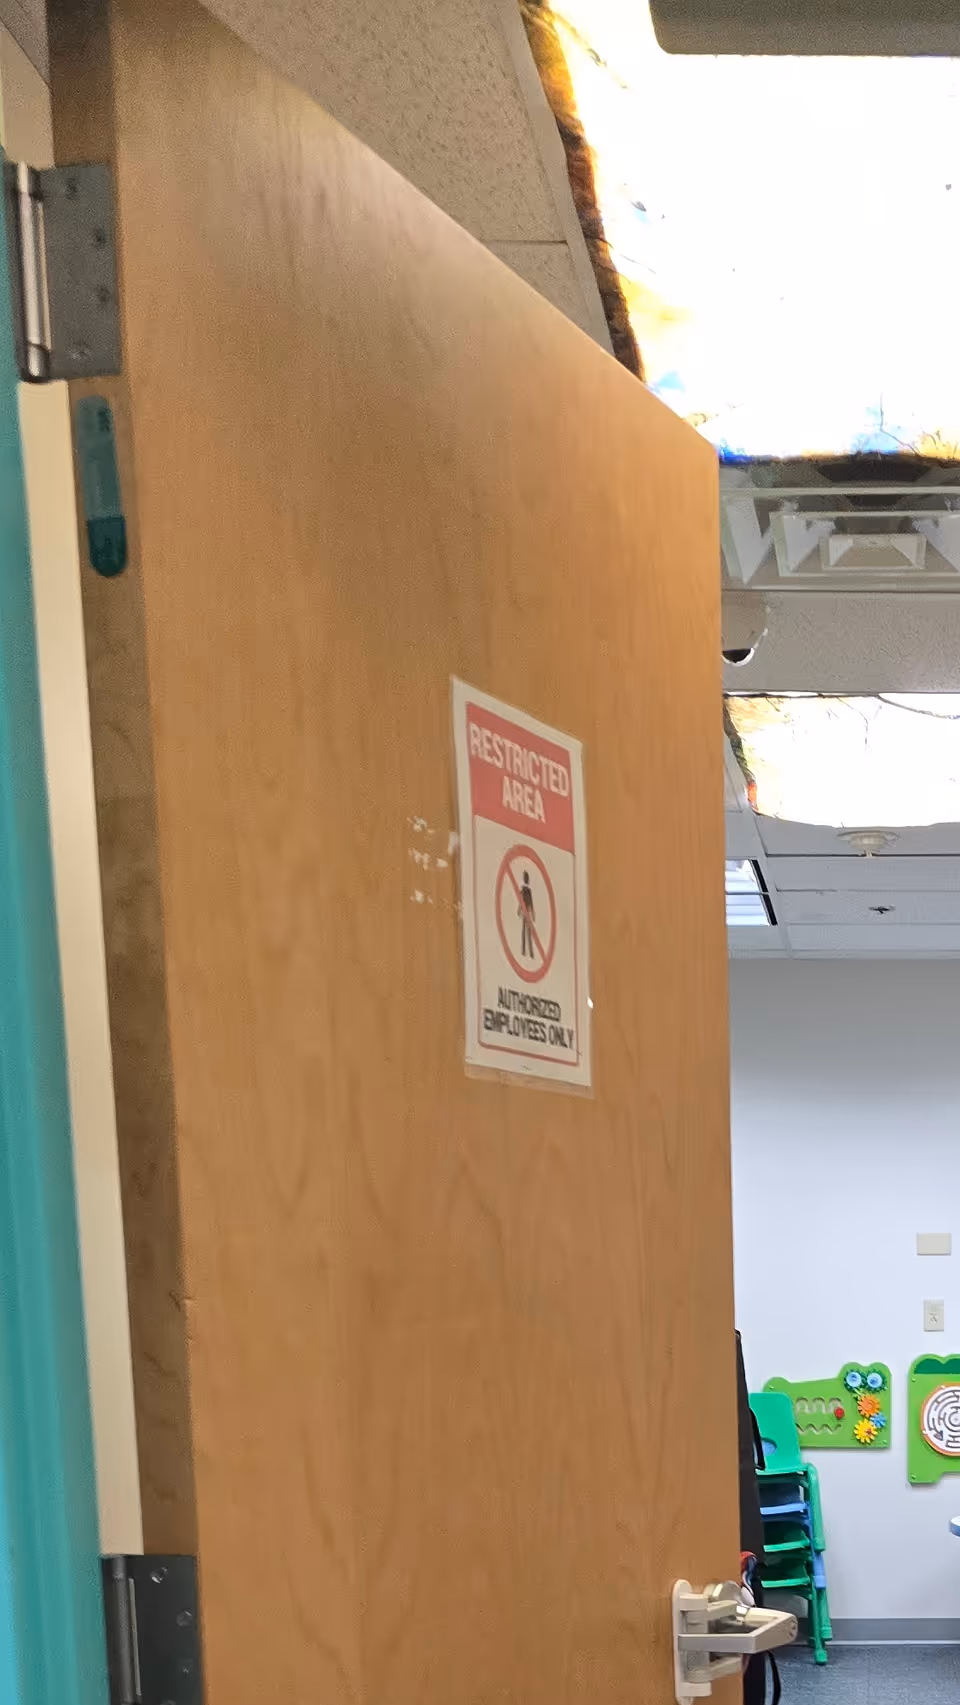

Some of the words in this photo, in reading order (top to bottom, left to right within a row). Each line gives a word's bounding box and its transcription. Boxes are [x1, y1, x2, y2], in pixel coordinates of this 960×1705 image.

[470, 722, 569, 797] RESTRICTED
[503, 776, 546, 824] AREA
[498, 986, 561, 1022] AUTHORIZED
[483, 1008, 546, 1043] EMPLOYEES
[548, 1024, 574, 1049] ONLY
